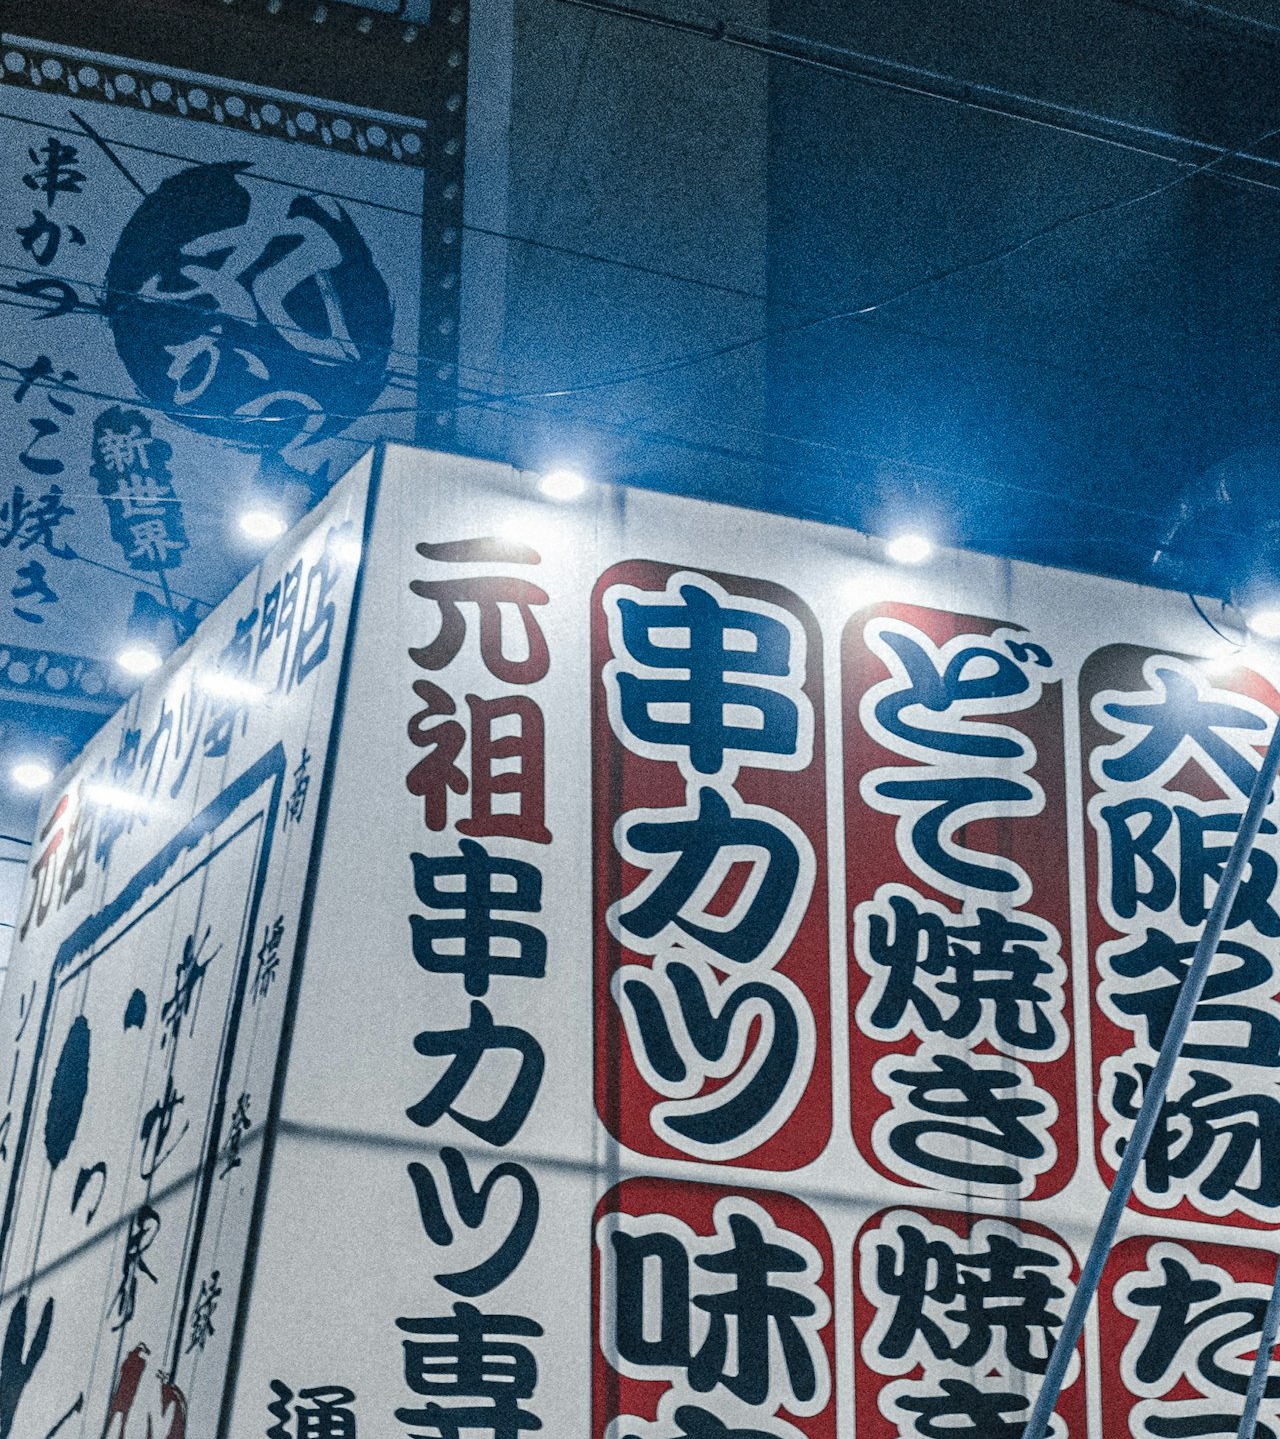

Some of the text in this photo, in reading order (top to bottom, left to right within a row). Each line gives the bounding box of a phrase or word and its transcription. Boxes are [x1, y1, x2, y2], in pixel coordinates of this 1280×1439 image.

[0, 136, 87, 623] 串かつ たこ焼き
[102, 424, 187, 565] 新世界
[613, 581, 806, 1149] 串カツ
[862, 622, 1054, 1190] どて焼き
